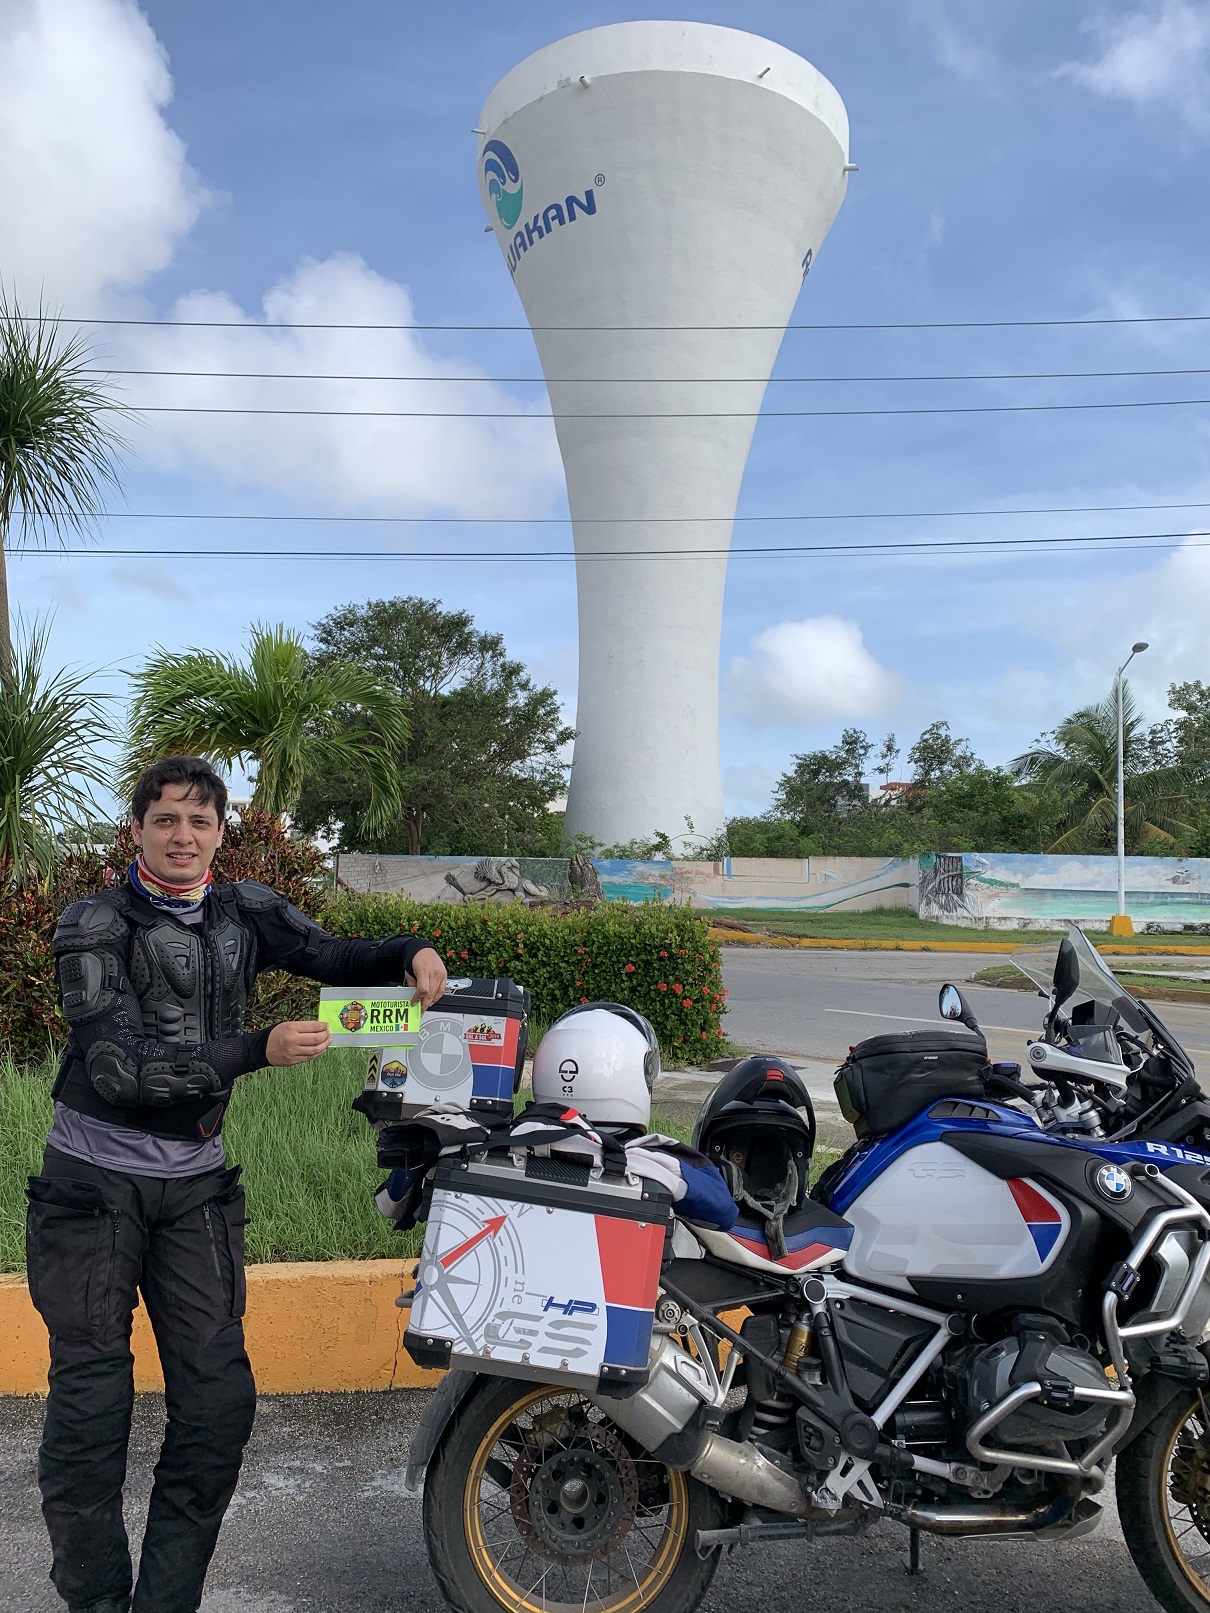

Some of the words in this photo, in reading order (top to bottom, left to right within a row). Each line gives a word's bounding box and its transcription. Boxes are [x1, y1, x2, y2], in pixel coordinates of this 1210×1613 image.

[507, 189, 597, 279] UAKAN
[370, 1000, 409, 1009] MOTOTURISTA
[369, 1008, 409, 1024] RRM
[562, 1085, 573, 1094] C3
[1145, 1141, 1170, 1157] R
[1170, 1146, 1210, 1167] 12
[1101, 1166, 1127, 1180] BMW
[542, 1296, 598, 1317] HP
[483, 1310, 598, 1359] GS
